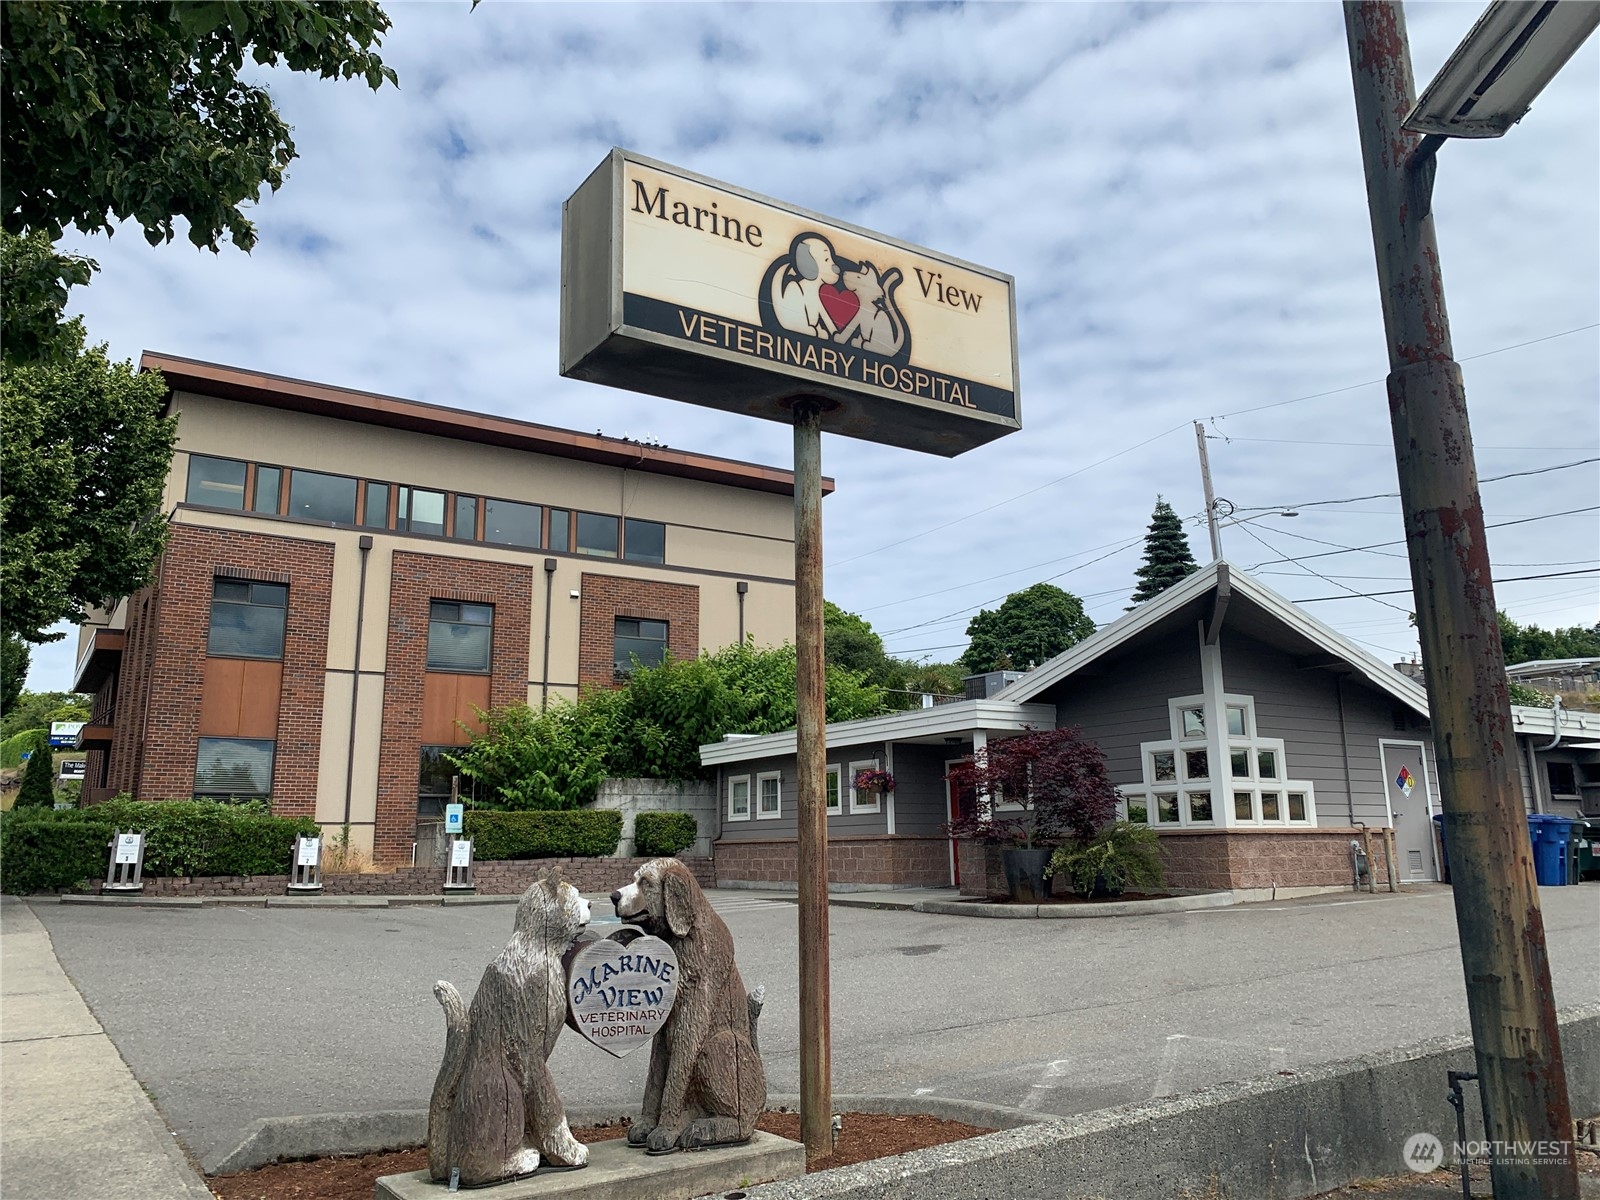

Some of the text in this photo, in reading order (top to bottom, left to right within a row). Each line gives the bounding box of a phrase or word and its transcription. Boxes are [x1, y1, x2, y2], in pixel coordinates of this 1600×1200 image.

[631, 179, 983, 314] Marine View
[678, 310, 978, 410] VETERINARY HOSPITAL
[573, 954, 675, 1005] MARINE
[597, 986, 664, 1009] VIEW
[579, 1009, 666, 1024] VETERINARY
[591, 1024, 651, 1038] HOSPITAL
